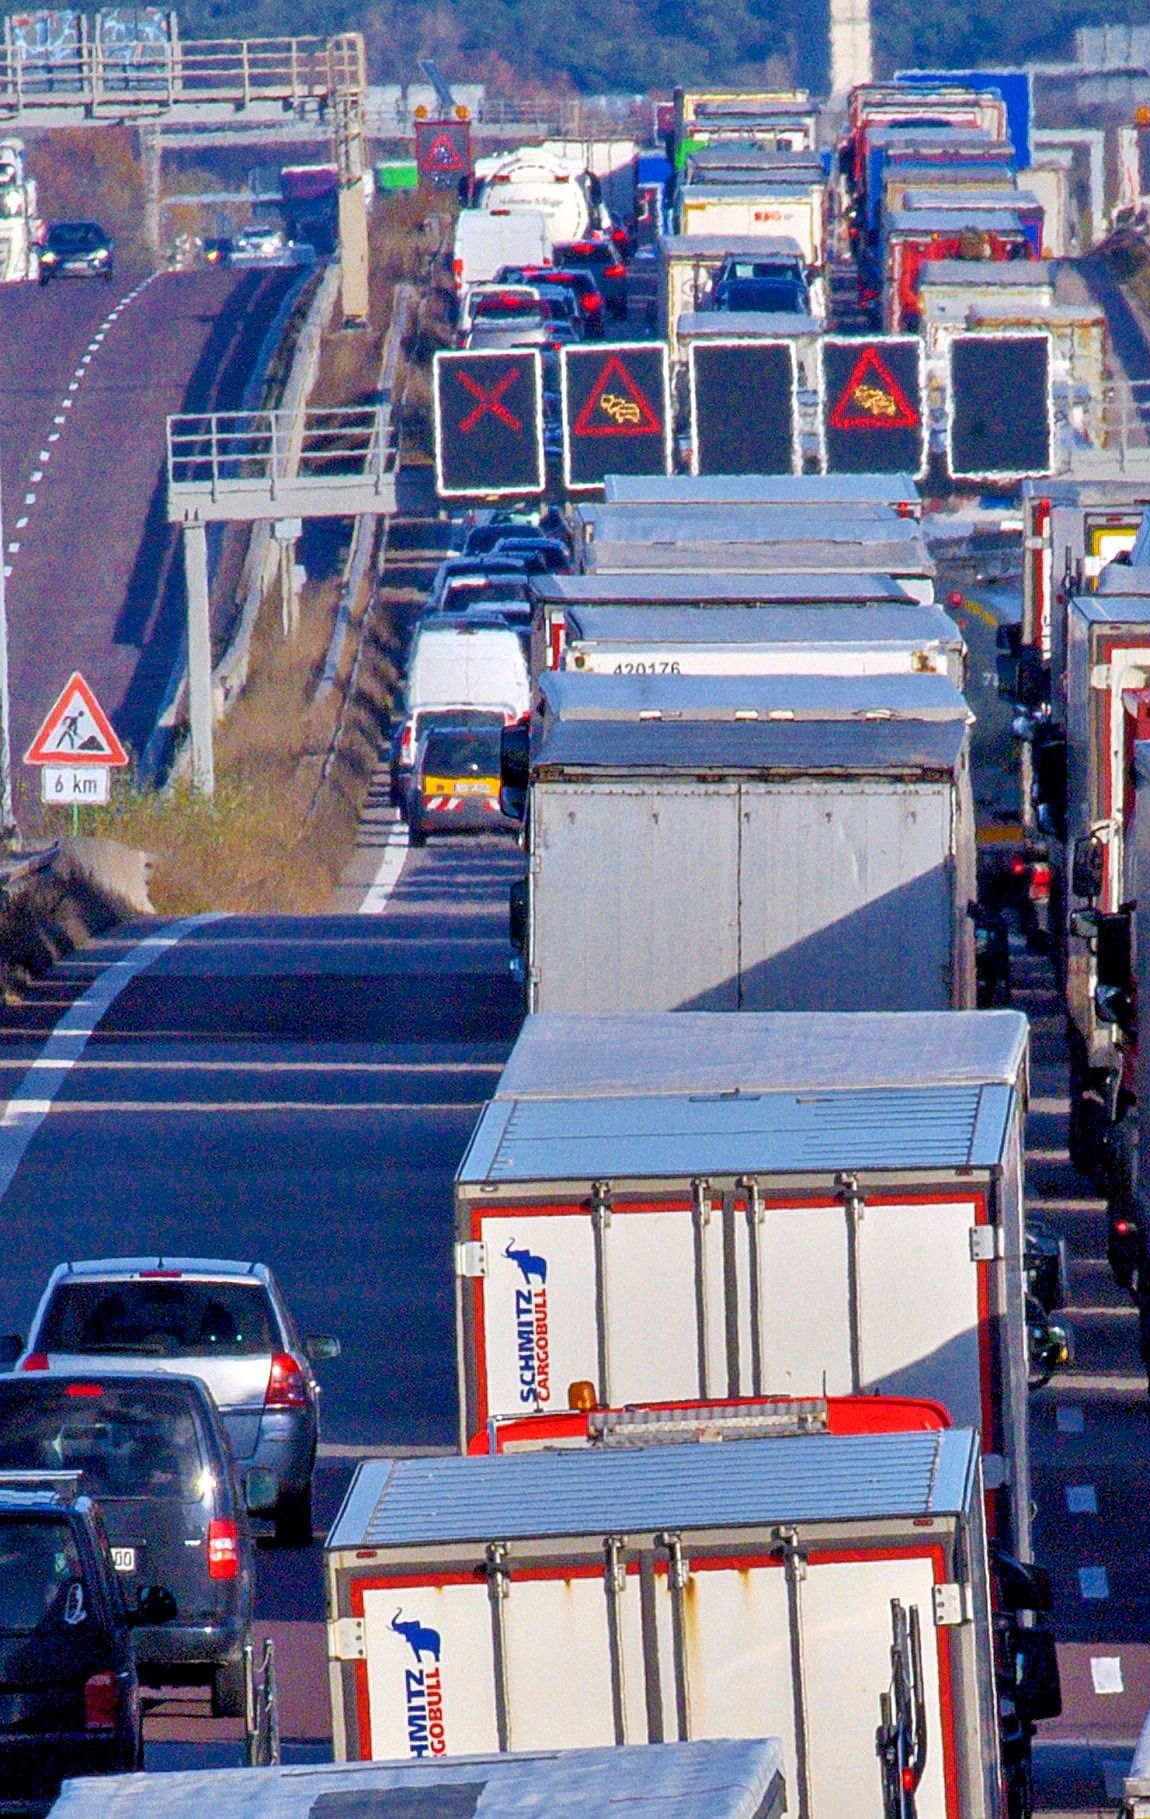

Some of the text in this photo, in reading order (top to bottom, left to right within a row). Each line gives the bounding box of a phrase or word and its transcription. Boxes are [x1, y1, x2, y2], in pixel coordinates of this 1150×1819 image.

[613, 660, 681, 674] 420176
[54, 774, 97, 794] 6 km
[515, 1289, 537, 1403] SCHMITZ
[534, 1287, 551, 1402] CARGOBULL
[425, 1667, 447, 1758] GOBULL
